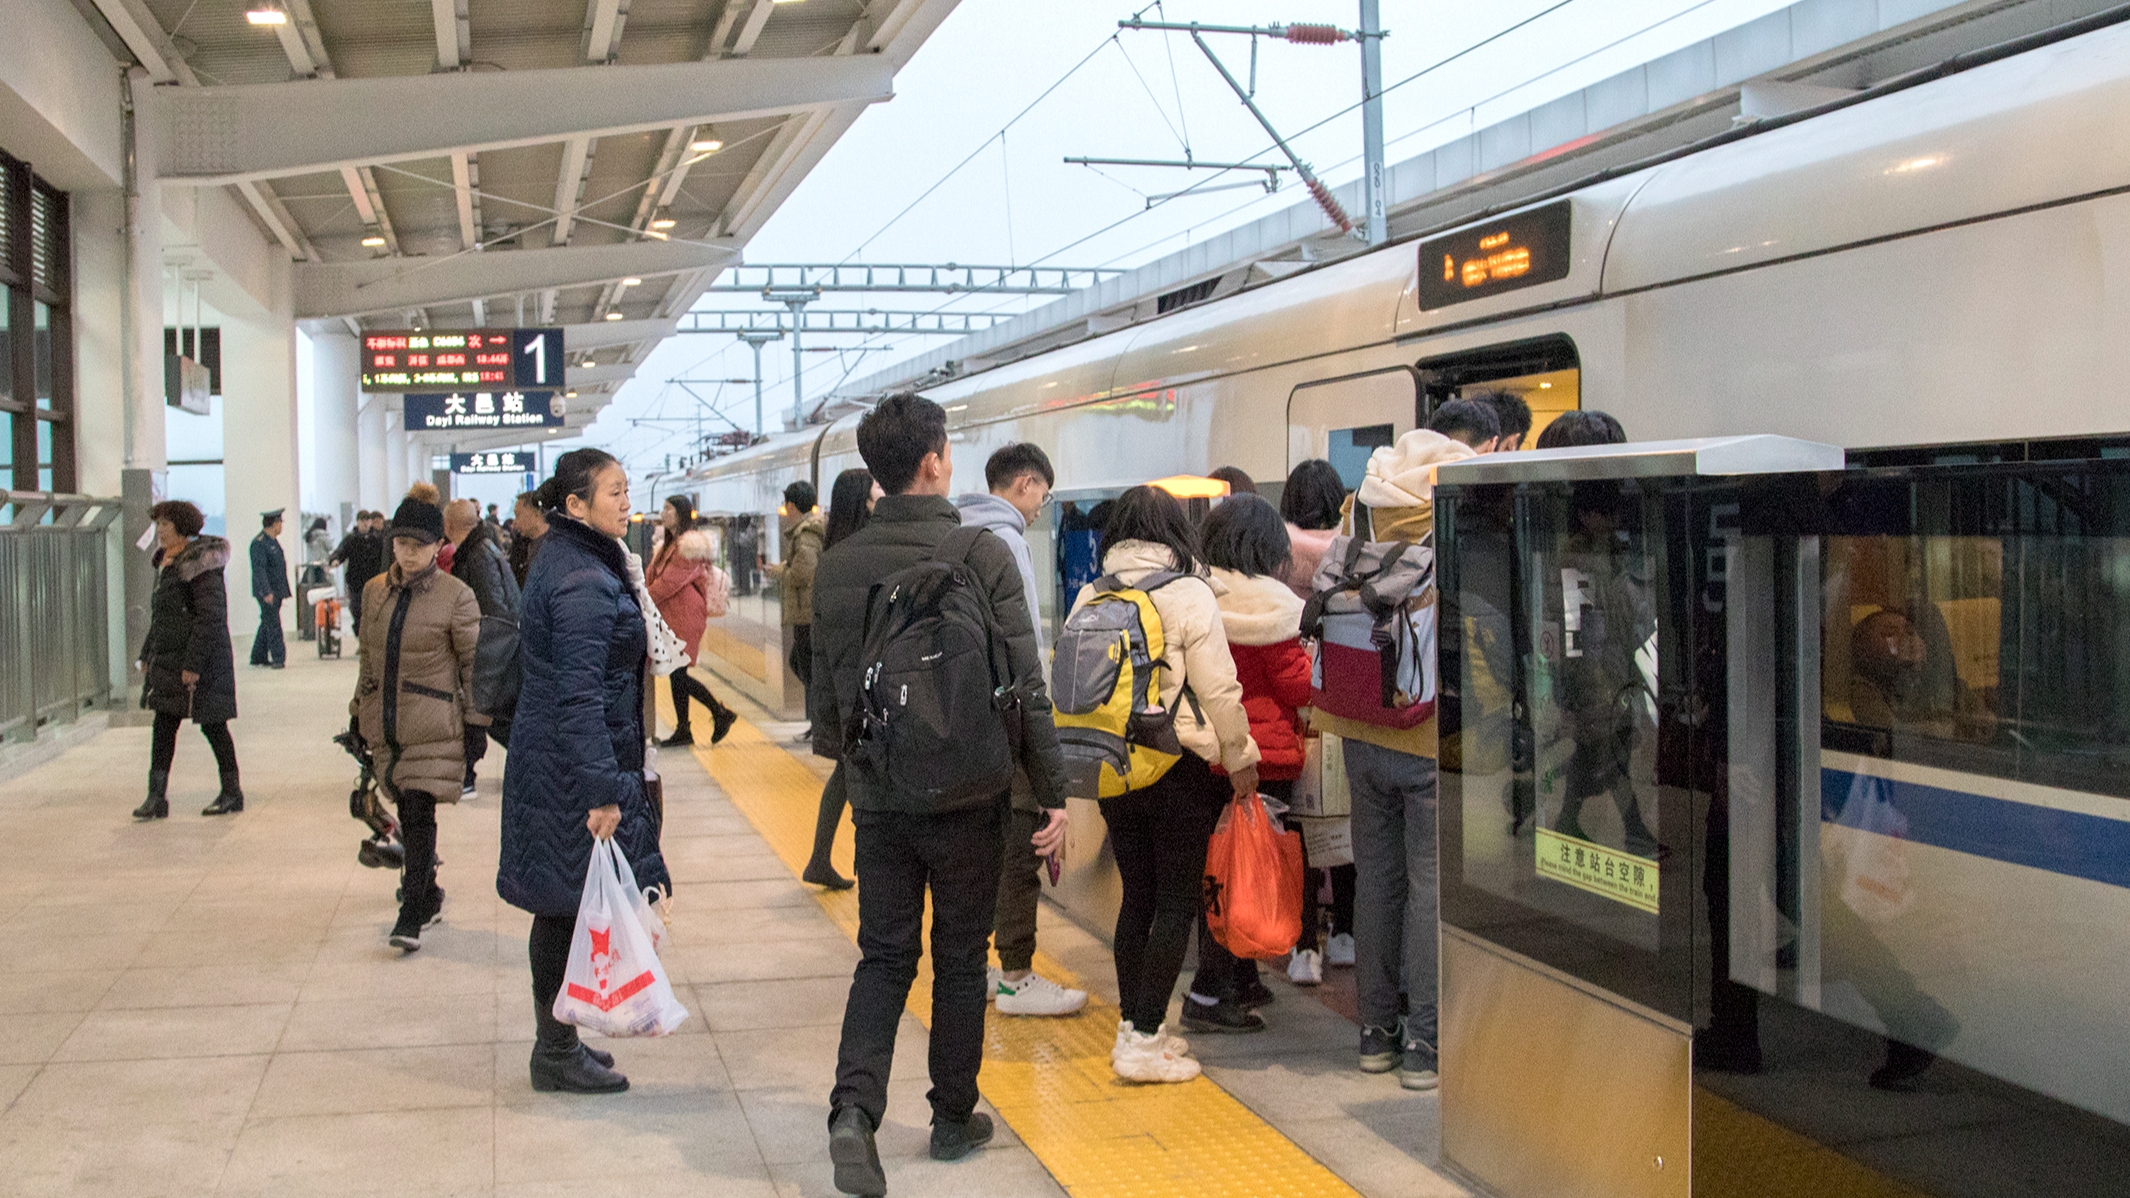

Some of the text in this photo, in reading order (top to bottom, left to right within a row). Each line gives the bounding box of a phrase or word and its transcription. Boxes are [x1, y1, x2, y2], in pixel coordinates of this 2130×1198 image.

[524, 333, 546, 384] 1
[444, 391, 525, 414] 大邑站
[426, 412, 543, 428] Dayi Railway Station
[1558, 862, 1572, 875] mind
[1572, 867, 1581, 878] the
[1582, 871, 1593, 882] gap
[1594, 874, 1617, 890] between
[1618, 881, 1628, 893] the
[1629, 885, 1643, 897] train
